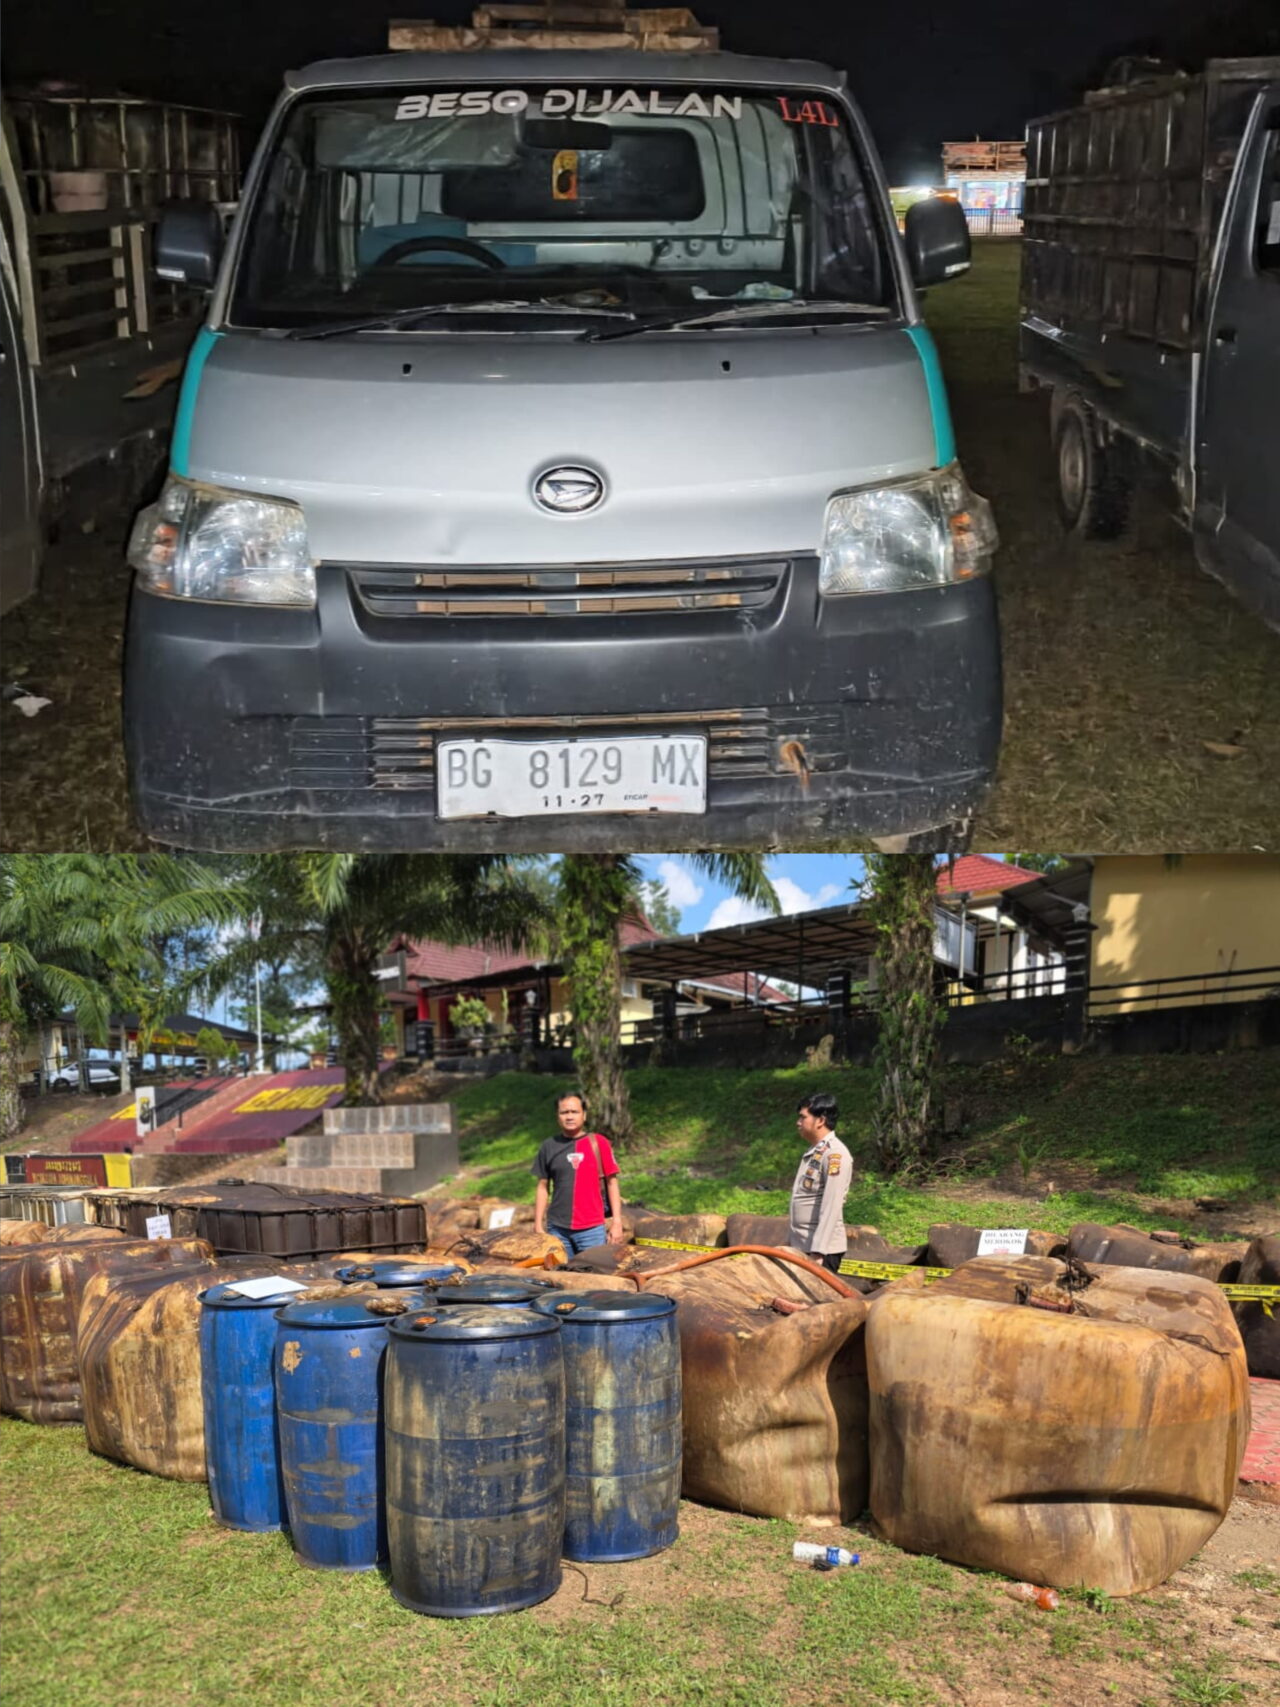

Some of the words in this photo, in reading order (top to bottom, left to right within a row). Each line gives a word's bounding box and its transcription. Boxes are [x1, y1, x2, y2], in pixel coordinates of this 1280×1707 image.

[394, 88, 529, 121] BESO
[541, 87, 743, 120] DIJALAN
[447, 747, 492, 789] BG
[528, 746, 622, 789] 8129
[651, 743, 700, 787] MX
